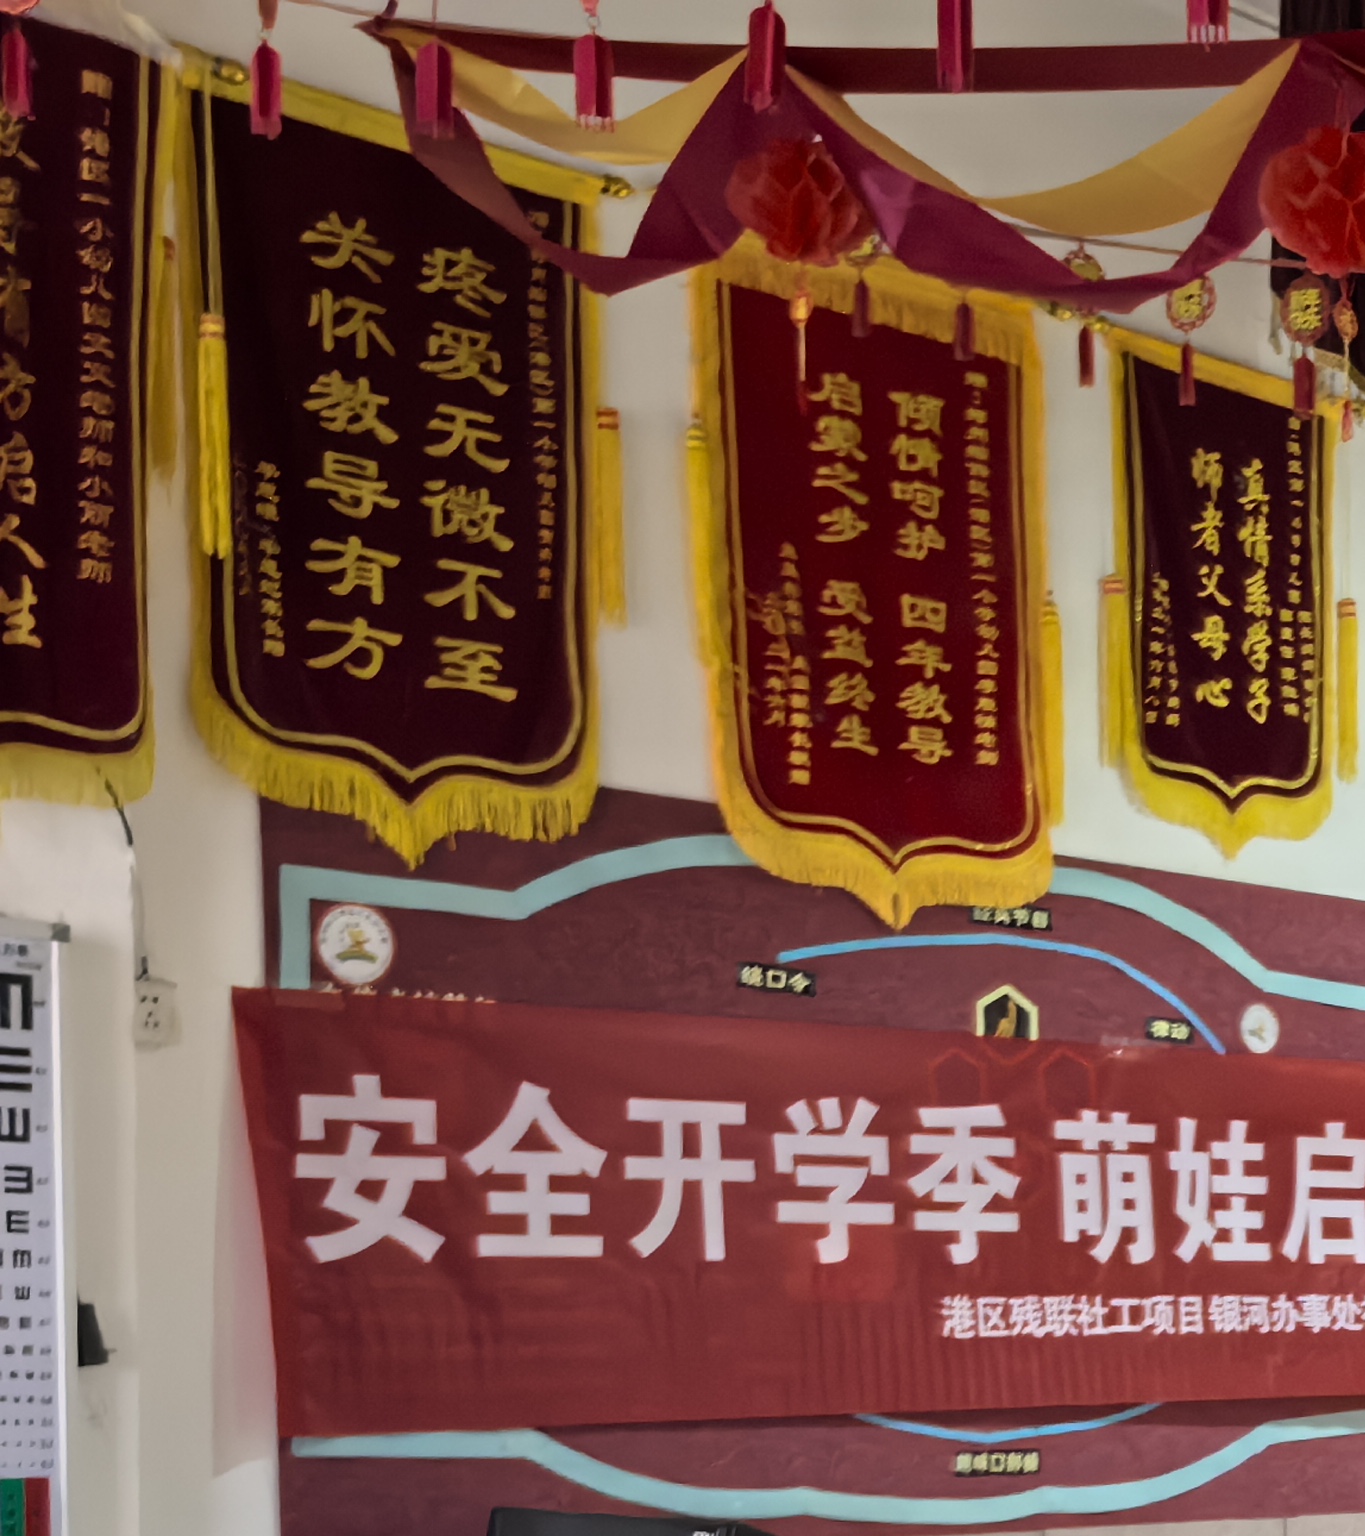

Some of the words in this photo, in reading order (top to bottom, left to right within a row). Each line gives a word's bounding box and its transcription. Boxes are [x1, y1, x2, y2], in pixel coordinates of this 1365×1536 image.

[299, 211, 404, 682] 关怀教导有方
[897, 593, 954, 766] 四年教导
[294, 1074, 1022, 1265] 安全开学季
[940, 1294, 1203, 1340] 港区残联社工项目
